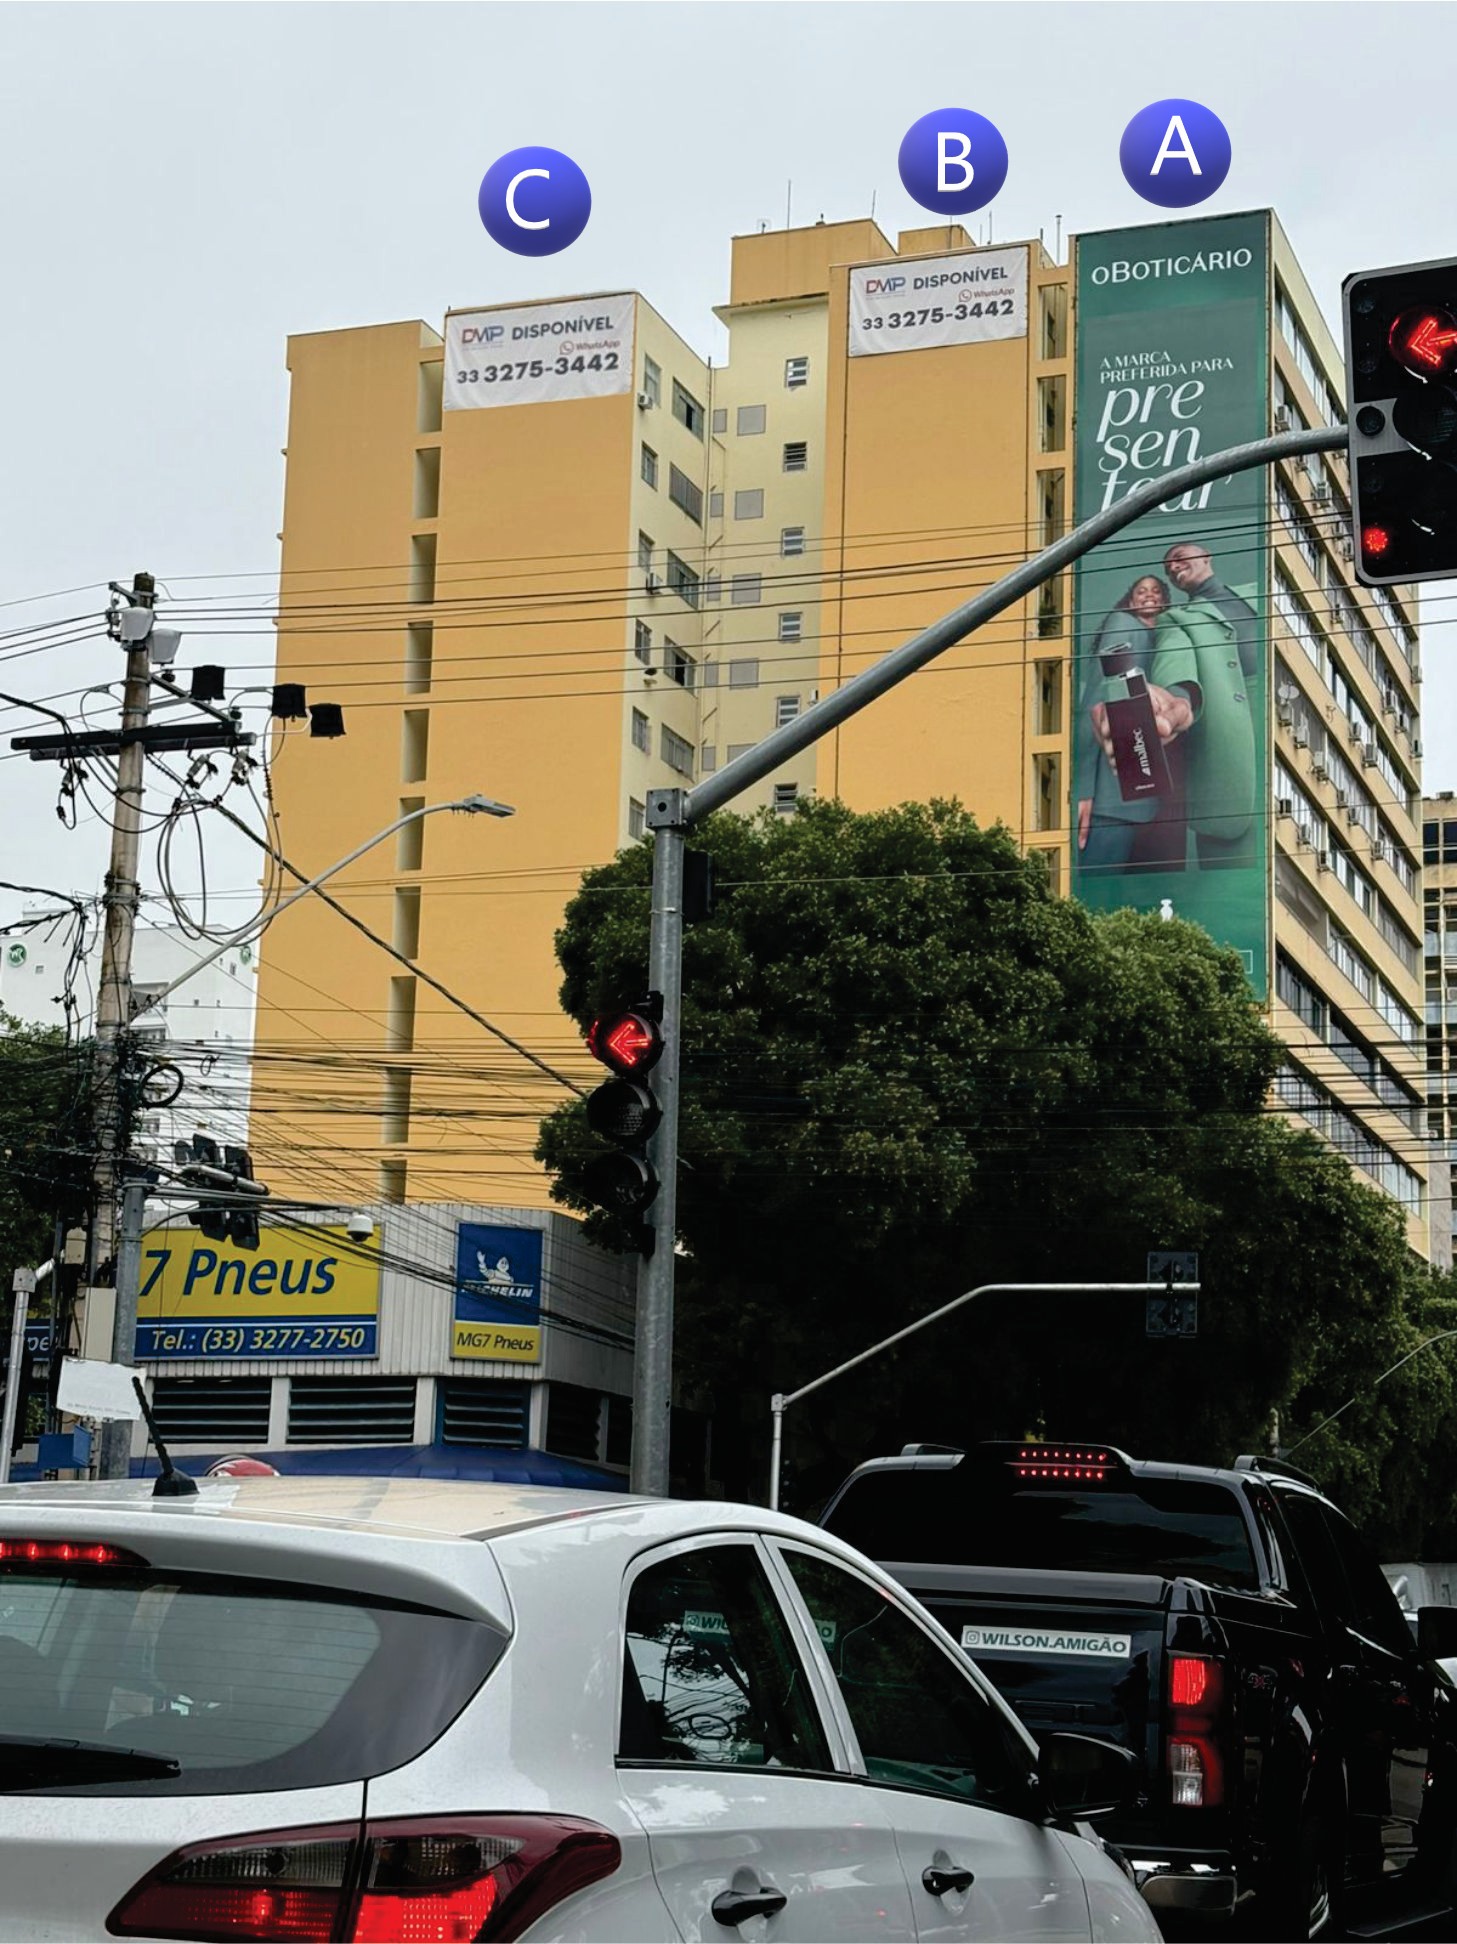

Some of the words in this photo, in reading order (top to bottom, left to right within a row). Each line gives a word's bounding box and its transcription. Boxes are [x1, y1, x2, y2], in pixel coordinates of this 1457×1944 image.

[913, 266, 1008, 290] DISPONÍVEL
[511, 315, 614, 341] DISPONÍVEL
[862, 317, 883, 331] 33
[888, 299, 1014, 329] 3275-3442
[457, 370, 479, 384] 33
[484, 352, 619, 383] 3275-3442
[1100, 357, 1112, 370] A
[1115, 351, 1172, 368] MARCA
[1100, 363, 1188, 384] PREFERIDA
[1191, 357, 1234, 374] PARA
[1096, 380, 1205, 443] pre
[1098, 426, 1204, 473] sen
[182, 1249, 338, 1296] Pneus
[152, 1330, 195, 1350] Tel.:
[202, 1328, 244, 1353] (33)
[249, 1327, 365, 1349] 3277-2750
[457, 1332, 492, 1348] MG7
[493, 1334, 535, 1351] Pneus
[982, 1632, 1127, 1653] WILSON.AMIGÃO
